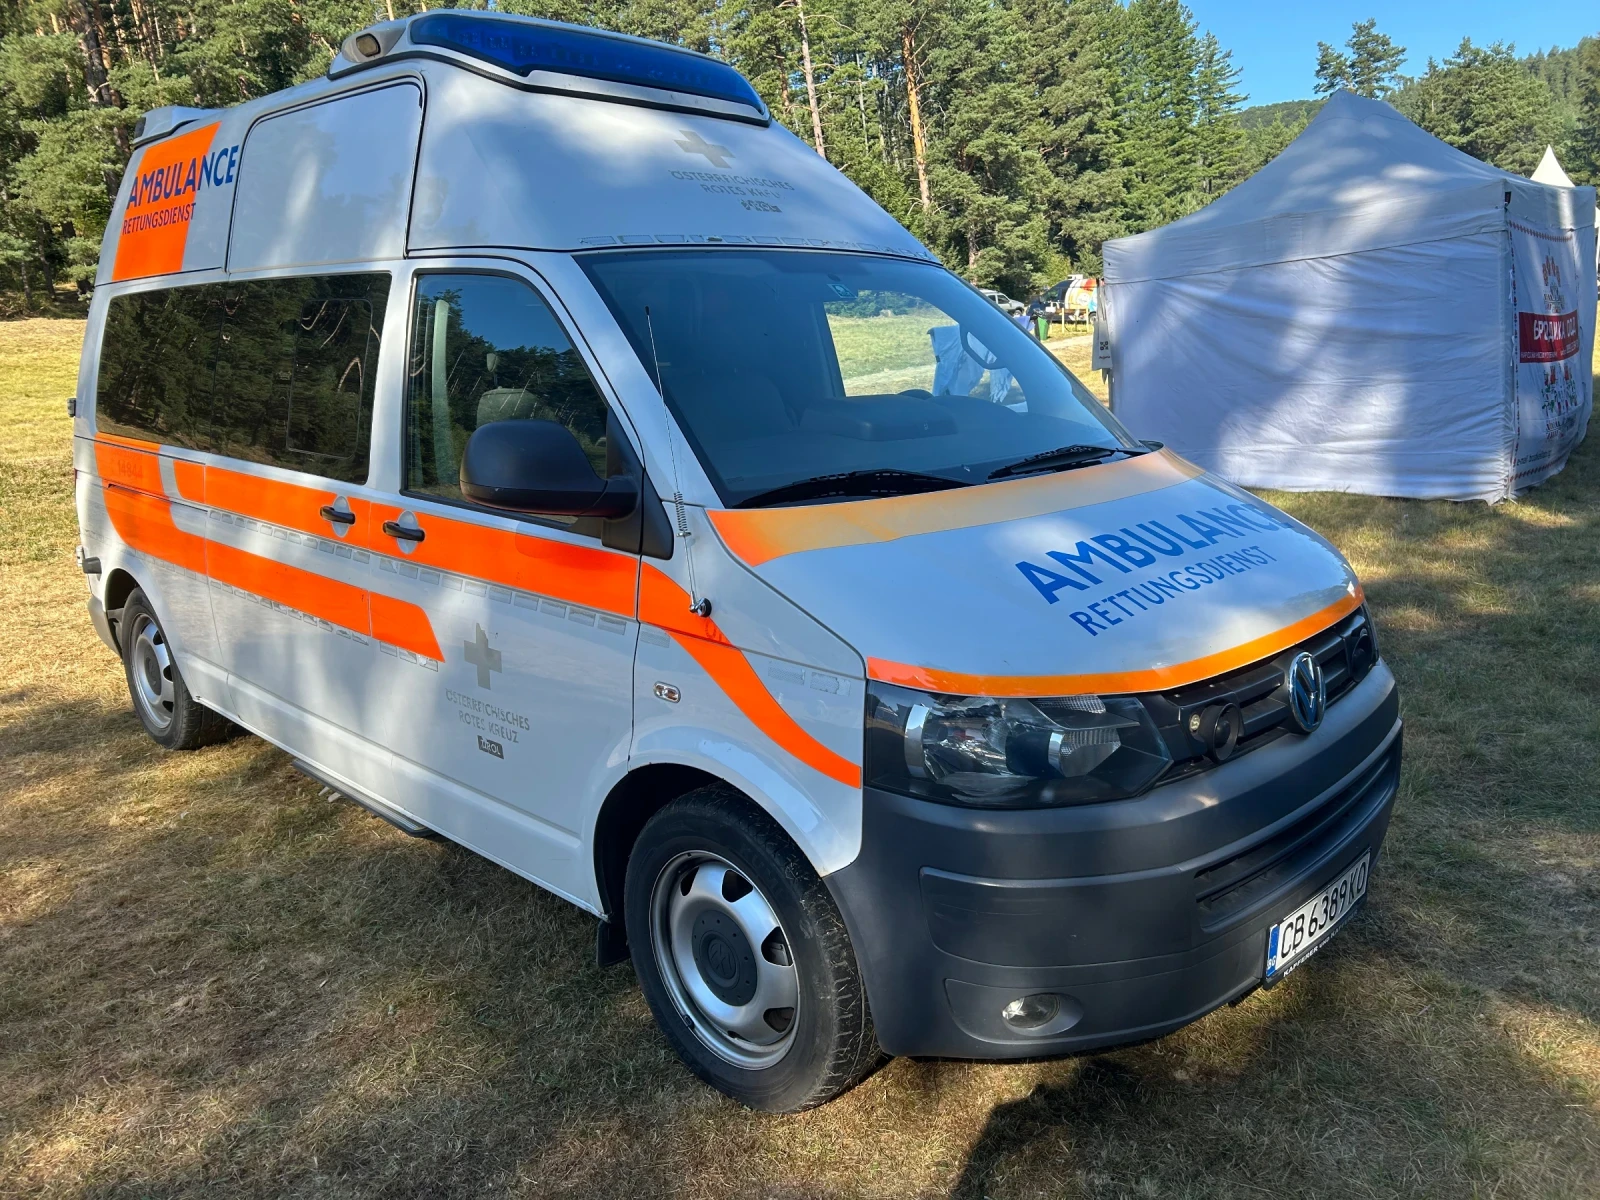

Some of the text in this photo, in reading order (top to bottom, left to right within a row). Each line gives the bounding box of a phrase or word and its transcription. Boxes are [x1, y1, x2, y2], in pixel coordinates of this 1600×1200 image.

[126, 144, 239, 210] AMBULANCE
[122, 203, 196, 235] RETTUNGSDIENST
[1015, 503, 1294, 604] AMBULANCE
[1069, 545, 1277, 636] RETTUNGSDIENST
[459, 710, 519, 743] ROTES KREUZ
